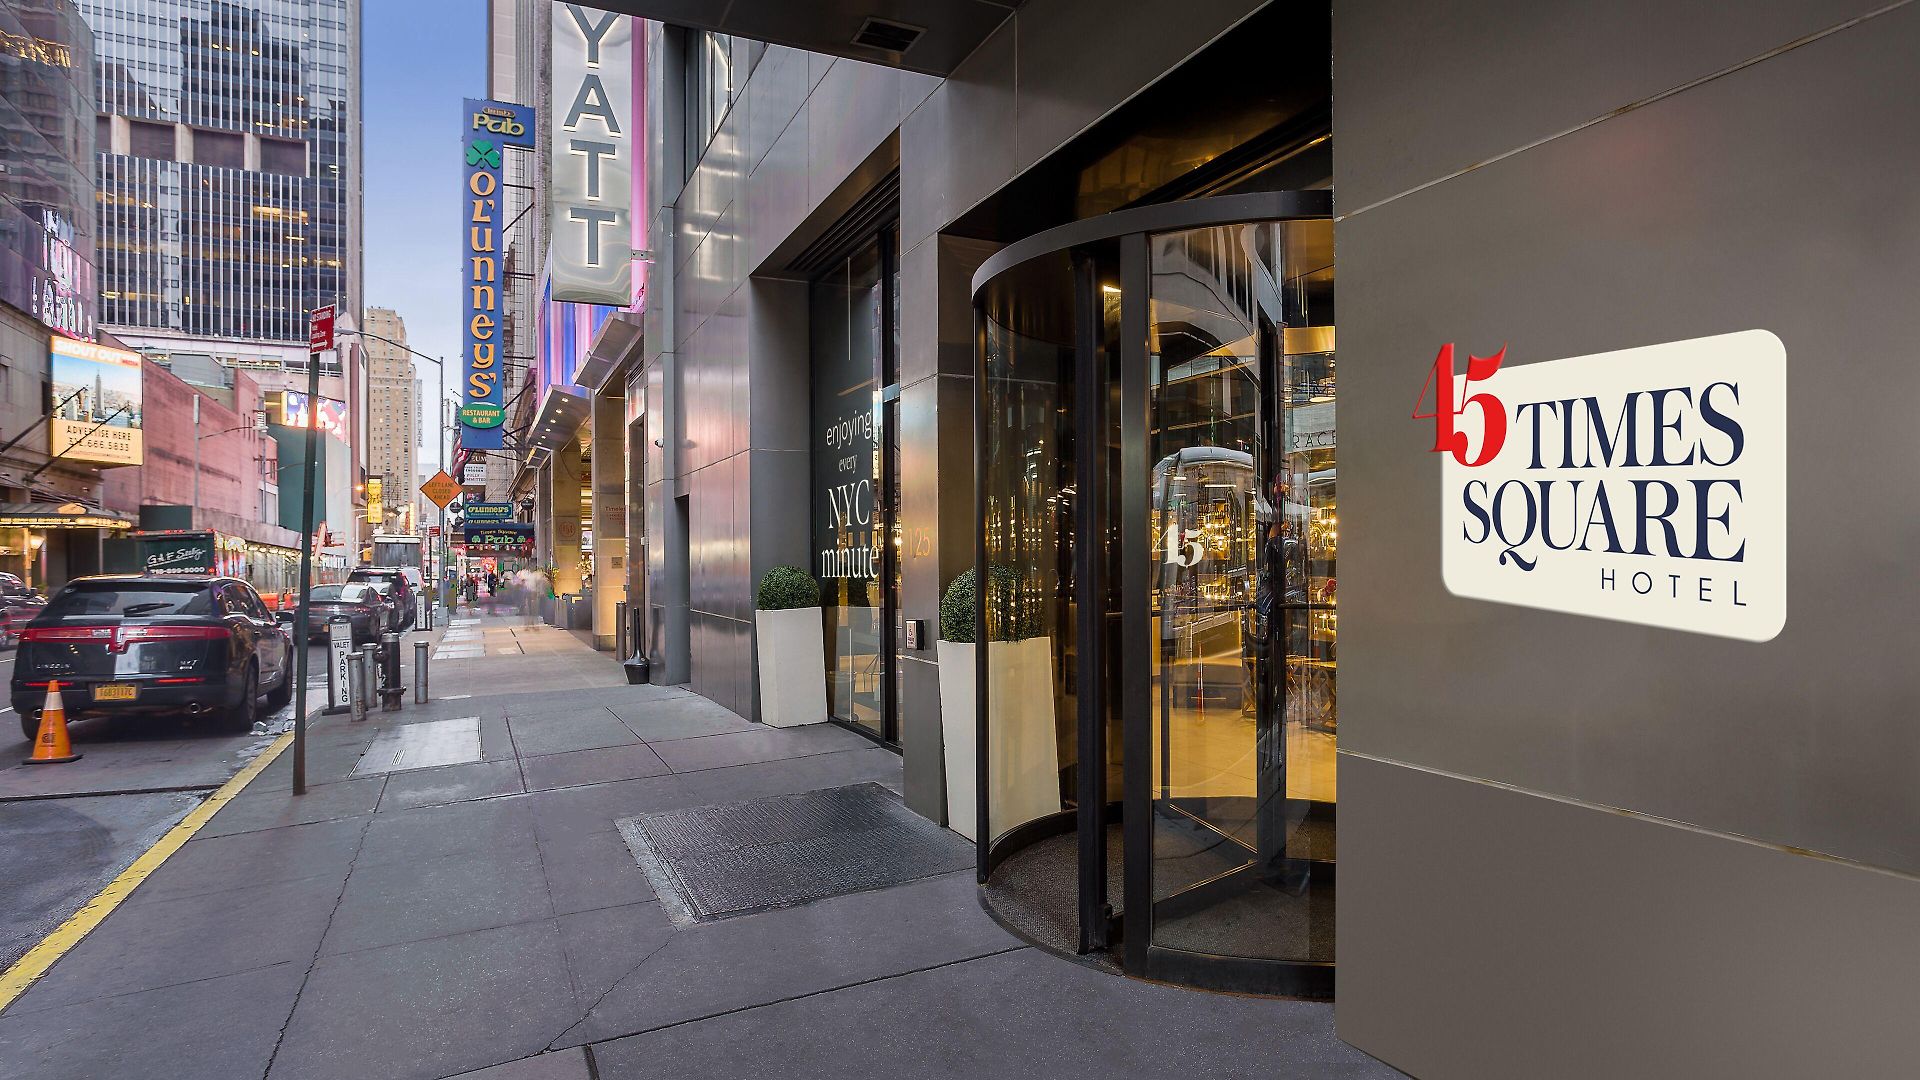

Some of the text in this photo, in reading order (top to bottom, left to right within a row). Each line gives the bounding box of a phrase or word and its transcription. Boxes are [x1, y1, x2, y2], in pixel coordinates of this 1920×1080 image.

[473, 112, 525, 136] Pub
[54, 340, 96, 360] SHOUT
[1412, 342, 1507, 467] 45
[67, 425, 131, 441] ADVERTISE HERE
[826, 408, 872, 450] enjoying
[1516, 382, 1745, 470] TIMES
[839, 453, 858, 474] every
[828, 479, 870, 529] NYC
[484, 534, 515, 544] Pub
[908, 527, 931, 557] 125
[1463, 480, 1746, 572] SQUARE
[821, 538, 880, 578] minute
[1152, 523, 1205, 569] 45
[1602, 568, 1747, 607] HOTEL
[333, 641, 350, 649] VALET
[339, 651, 348, 703] PARKING
